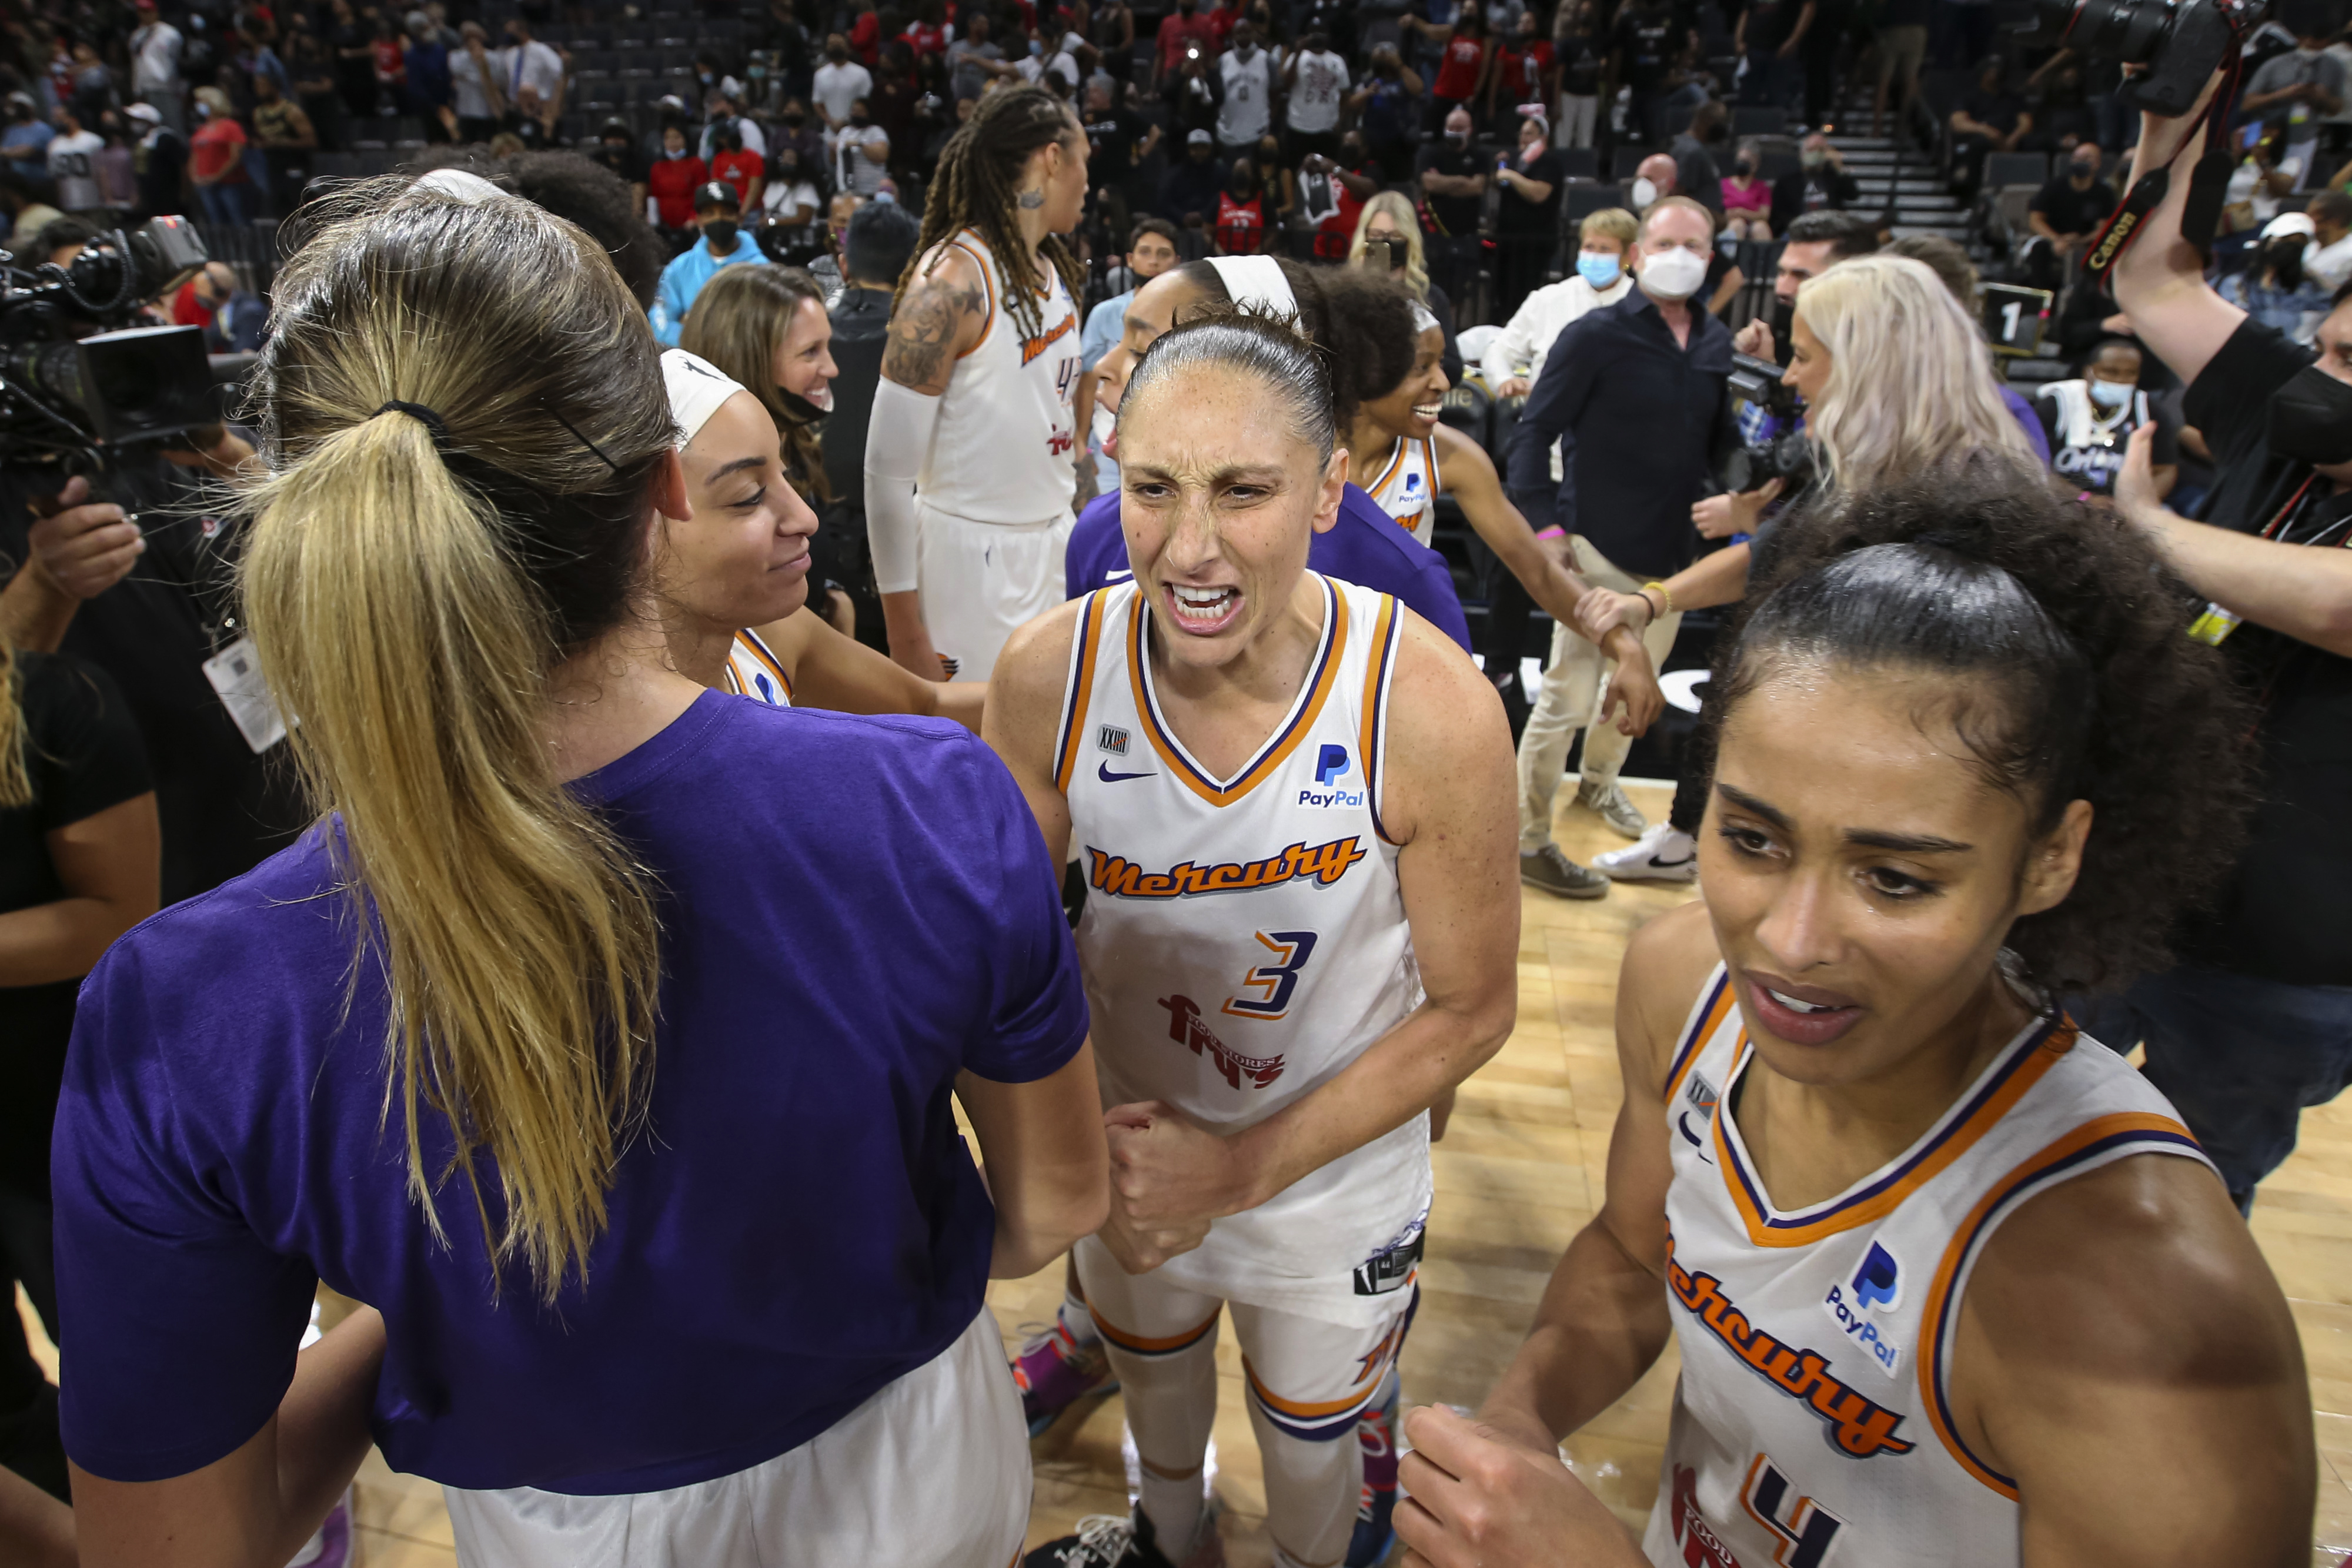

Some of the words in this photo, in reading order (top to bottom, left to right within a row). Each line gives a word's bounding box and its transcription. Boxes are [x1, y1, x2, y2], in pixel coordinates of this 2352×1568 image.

[2089, 212, 2137, 270] Canon
[2001, 301, 2022, 341] 1
[1399, 494, 1426, 503] PayPa
[1298, 790, 1364, 808] PayPal
[1086, 835, 1368, 900] Mercury
[1221, 931, 1318, 1021] 3
[1188, 1014, 1218, 1044] FOOD
[1220, 1045, 1275, 1068] STORES
[1665, 1212, 1917, 1460] ercury
[1825, 1285, 1896, 1369] PayPal
[1685, 1507, 1733, 1565] FOOD
[1739, 1452, 1842, 1568] 4
